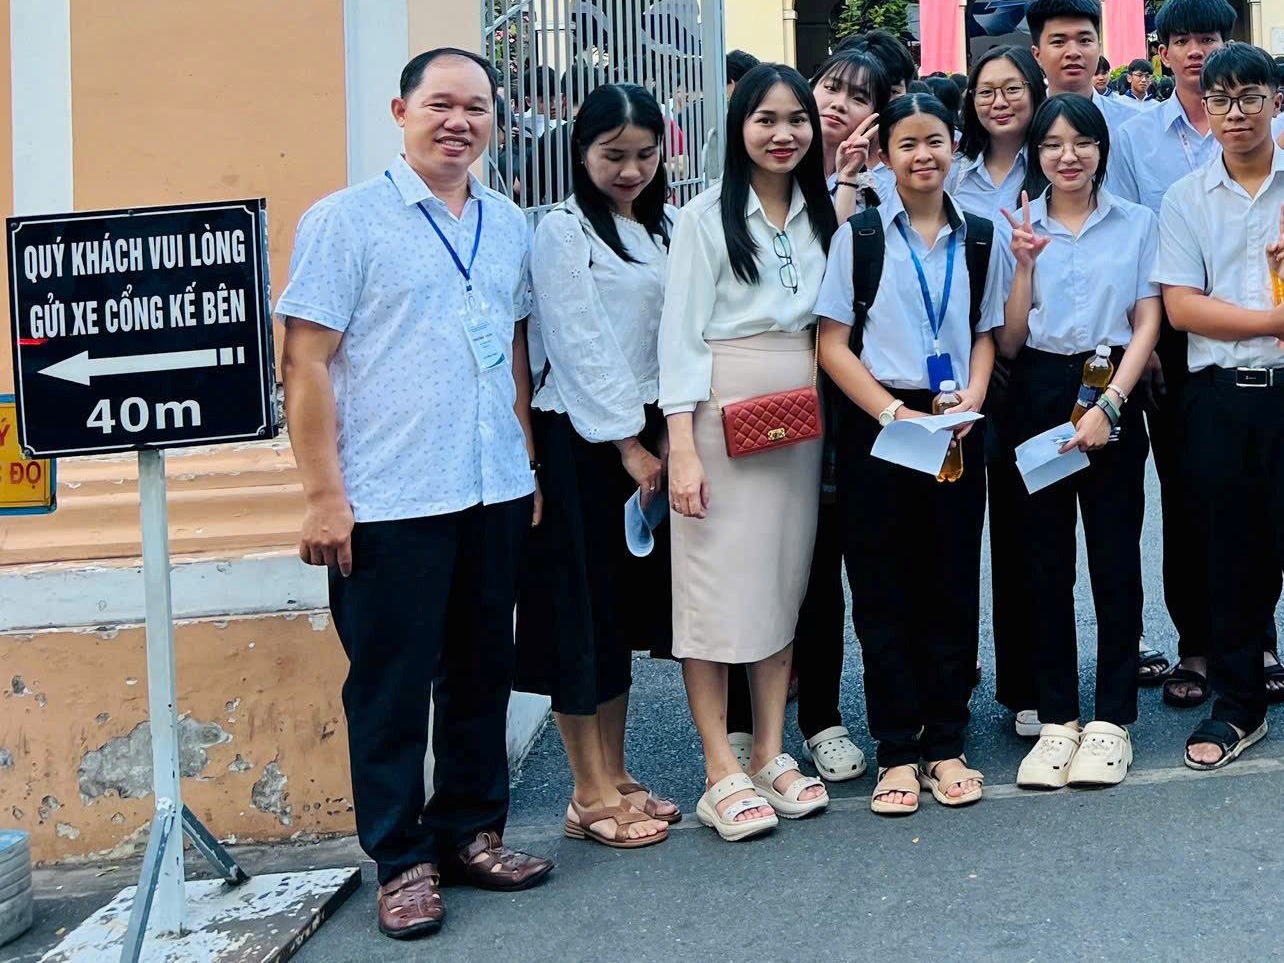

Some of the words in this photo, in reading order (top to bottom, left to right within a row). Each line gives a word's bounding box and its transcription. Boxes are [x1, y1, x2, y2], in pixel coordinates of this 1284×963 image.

[24, 236, 64, 284] QUÝ
[71, 233, 143, 276] KHÁCH
[148, 234, 184, 270] VUI
[190, 224, 246, 268] LÒNG
[29, 292, 65, 340] GỬI
[71, 300, 99, 336] XE
[105, 284, 164, 334] CỔNG
[170, 282, 197, 328] KẾ
[202, 283, 246, 325] BÊN
[86, 396, 201, 434] 40m
